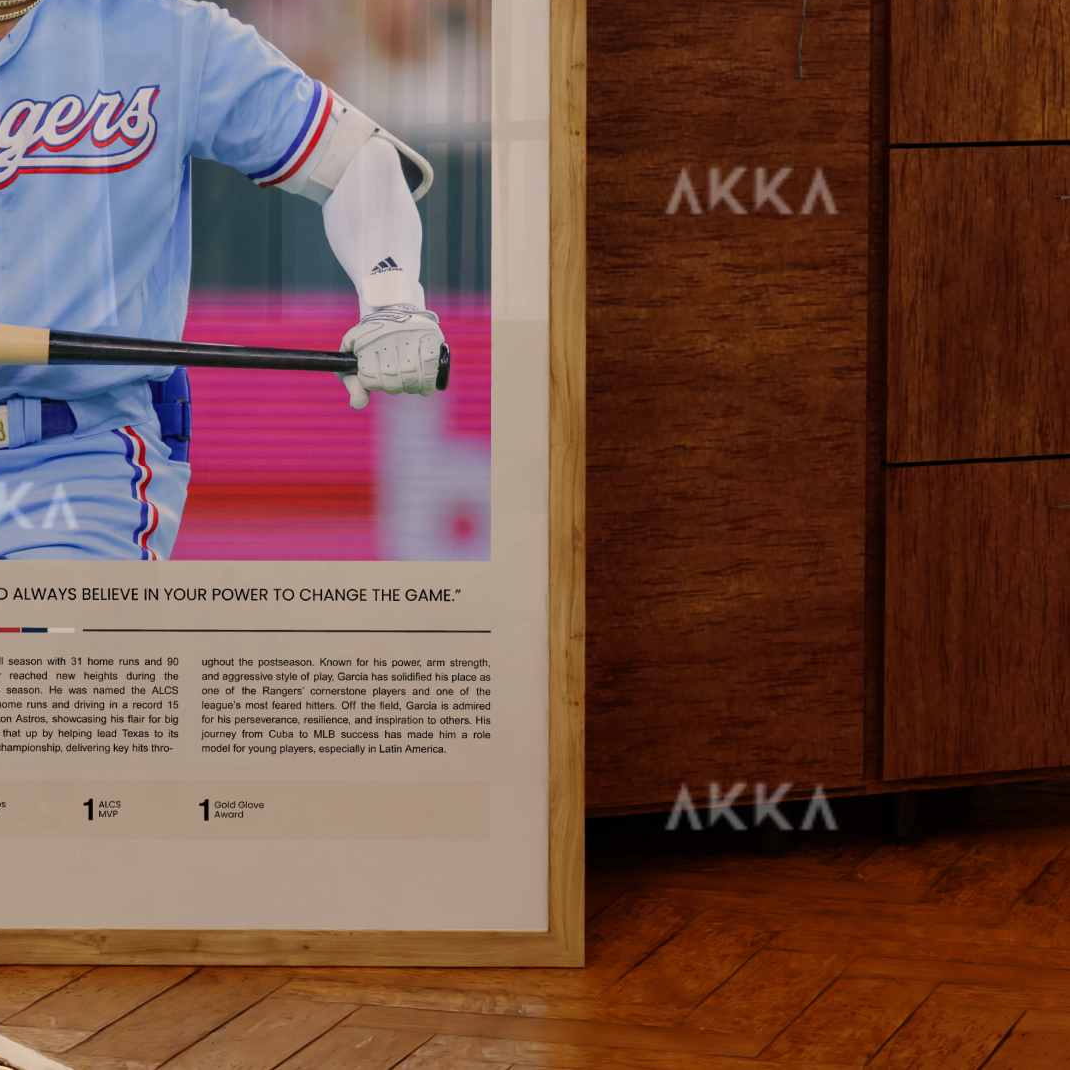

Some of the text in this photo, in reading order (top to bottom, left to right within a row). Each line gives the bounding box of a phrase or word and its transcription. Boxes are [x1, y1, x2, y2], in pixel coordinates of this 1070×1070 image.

[13, 588, 77, 600] ALWAYS
[82, 588, 138, 601] BELIEVE
[144, 588, 158, 601] IN
[164, 588, 207, 601] YOUR
[212, 588, 268, 601] POWER
[273, 588, 294, 601] TO
[300, 588, 367, 601] CHANGE
[372, 589, 400, 601] THE
[405, 589, 461, 602] GAME.”
[47, 657, 66, 665] with
[71, 657, 81, 665] 31
[88, 657, 114, 665] home
[145, 657, 162, 666] and
[167, 657, 179, 666] 90
[202, 657, 234, 668] ughout
[238, 658, 253, 666] the
[258, 658, 314, 668] postseason.
[320, 658, 352, 666] Known
[356, 658, 369, 666] for
[374, 658, 387, 666] his
[392, 660, 421, 668] power,
[450, 658, 490, 669] strength,
[83, 798, 121, 821] 1 ALCS
[199, 799, 264, 821] 1 Gold Glove
[214, 810, 243, 818] Award
